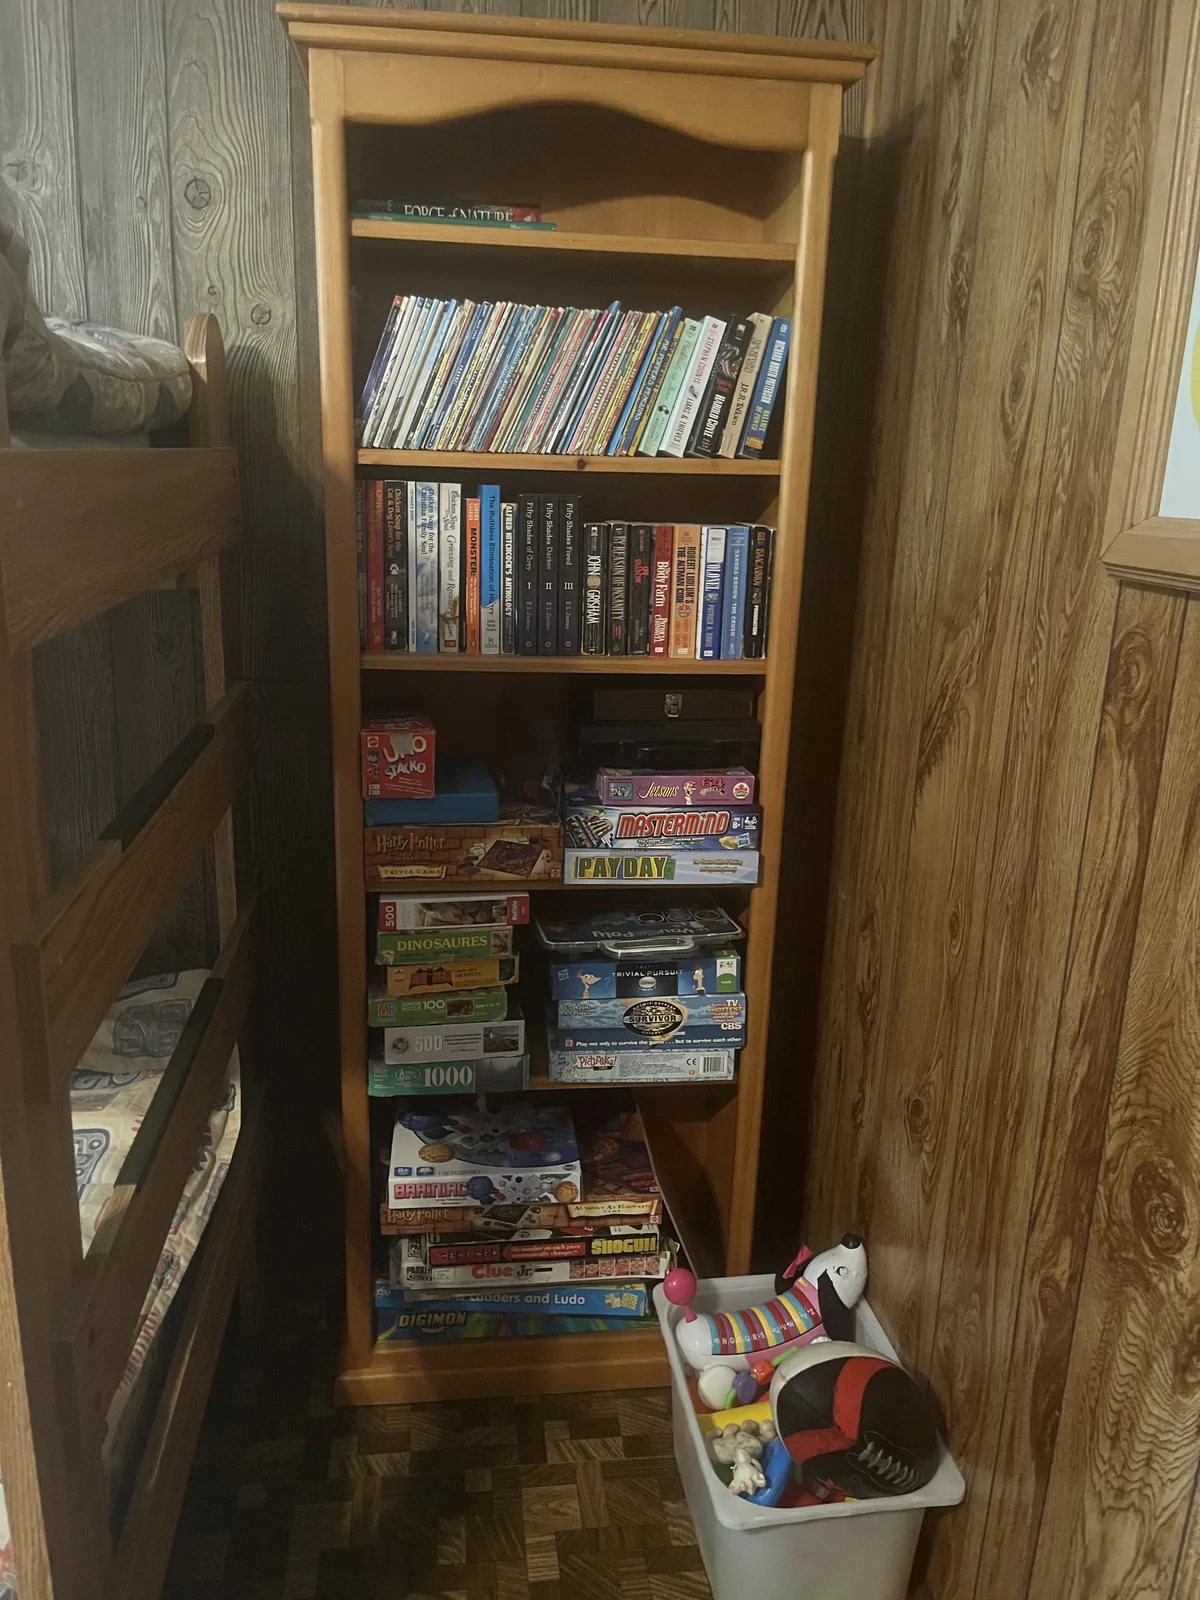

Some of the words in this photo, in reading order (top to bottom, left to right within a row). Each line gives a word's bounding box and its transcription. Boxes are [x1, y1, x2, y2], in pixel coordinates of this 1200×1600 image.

[405, 205, 444, 217] FORCE
[460, 209, 513, 222] NATURE
[700, 336, 714, 361] STEPHEN
[692, 361, 706, 384] COONTS
[760, 376, 775, 404] PATTERSON
[633, 386, 651, 422] PENGUINS
[682, 397, 694, 414] LIARS
[708, 393, 726, 420] HAROLD
[731, 402, 744, 426] Tolkien
[672, 419, 686, 443] THIEVES
[702, 417, 718, 438] COYLE
[386, 507, 394, 520] Dog
[505, 504, 513, 530] ALFRED
[525, 502, 534, 518] Fifty
[545, 502, 553, 519] Fifty
[565, 503, 573, 519] Fifty
[419, 518, 427, 539] Family
[526, 519, 534, 544] Shades
[613, 536, 625, 545] BY
[446, 535, 456, 568] Grieving
[469, 528, 477, 576] MONSTER:
[505, 532, 513, 575] HITCHCOCK'S
[612, 547, 625, 576] REASON
[677, 547, 685, 558] THE
[687, 547, 696, 570] ROBERT
[525, 554, 534, 571] Grey
[587, 555, 601, 576] JOHN
[654, 561, 669, 583] Body
[676, 560, 685, 586] ALTMAN
[545, 582, 552, 590] II
[564, 582, 573, 590] III
[612, 577, 624, 586] OF
[686, 572, 695, 604] LUDLUM'S
[704, 563, 721, 592] OLONEL
[446, 583, 455, 615] Recovery
[587, 589, 600, 624] GRISHAM
[611, 587, 624, 620] INSANITY
[655, 585, 668, 607] Farm
[676, 588, 684, 604] CODE
[382, 735, 426, 762] UO
[384, 760, 426, 779] STACKO
[637, 782, 679, 799] Jetsons
[701, 777, 724, 787] 64
[376, 835, 408, 852] Harry
[409, 832, 445, 853] Potter
[386, 905, 394, 926] 500
[397, 935, 487, 950] DINOSAURES
[377, 1002, 396, 1016] MB
[423, 1000, 444, 1009] 100
[720, 1022, 741, 1030] CBS
[414, 1035, 442, 1052] 500
[423, 1065, 472, 1087] 1000
[394, 1182, 467, 1198] BRAINIAC
[386, 1210, 415, 1221] Harry
[416, 1209, 448, 1222] Potter
[590, 1236, 656, 1255] SHOGUN
[472, 1264, 512, 1277] Clue
[516, 1265, 533, 1277] Jr.
[524, 1293, 549, 1303] and
[554, 1293, 585, 1304] Ludo
[398, 1312, 467, 1325] DIGIMON
